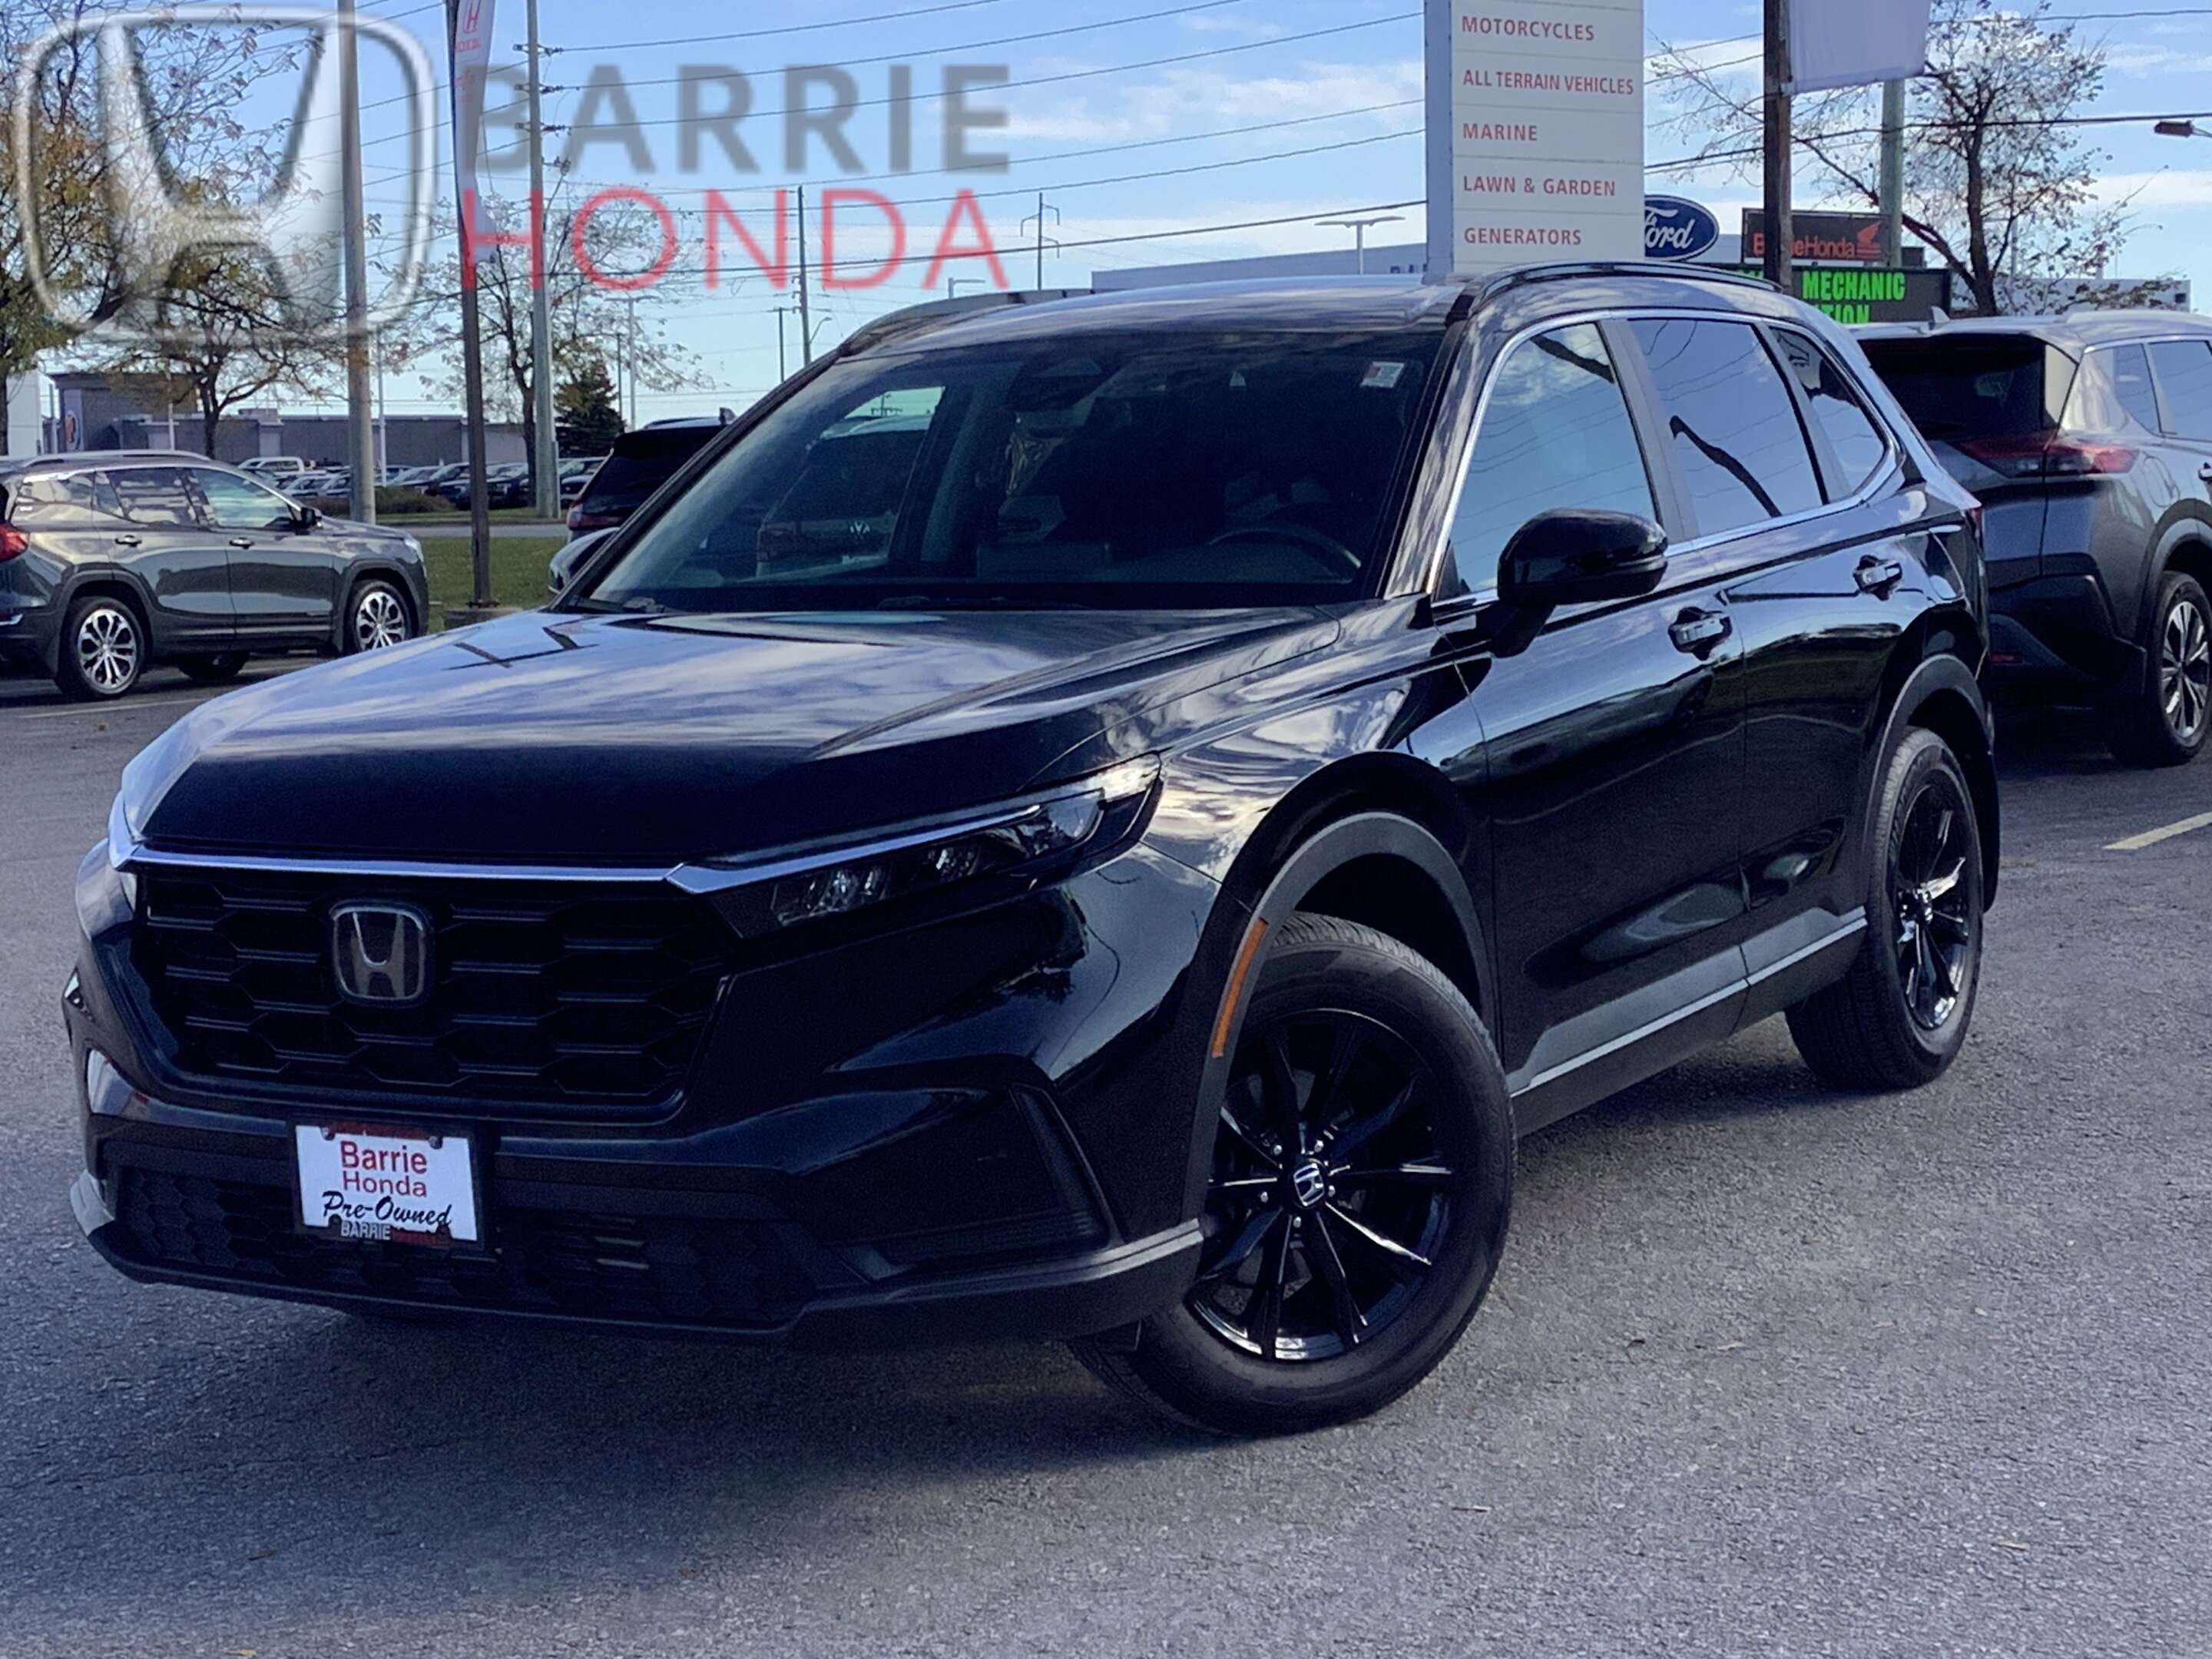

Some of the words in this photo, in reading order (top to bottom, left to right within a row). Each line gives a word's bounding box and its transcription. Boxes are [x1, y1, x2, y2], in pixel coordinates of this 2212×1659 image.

[1462, 15, 1594, 41] MOTORCYCLES
[1462, 69, 1492, 87] ALL
[1496, 71, 1560, 91] TERRAIN
[1564, 75, 1634, 95] VEHICLES
[1462, 123, 1538, 141] MARINE
[1463, 175, 1515, 193] LAWN
[1524, 177, 1535, 194] &
[1543, 178, 1615, 196] GARDEN
[1464, 227, 1581, 246] GENERATORS
[1802, 270, 1906, 300] MECHANIC
[340, 1141, 427, 1174] Barrie
[343, 1171, 427, 1197] Honda
[322, 1190, 452, 1226] Pre-Owned
[340, 1220, 392, 1241] BARRIE
